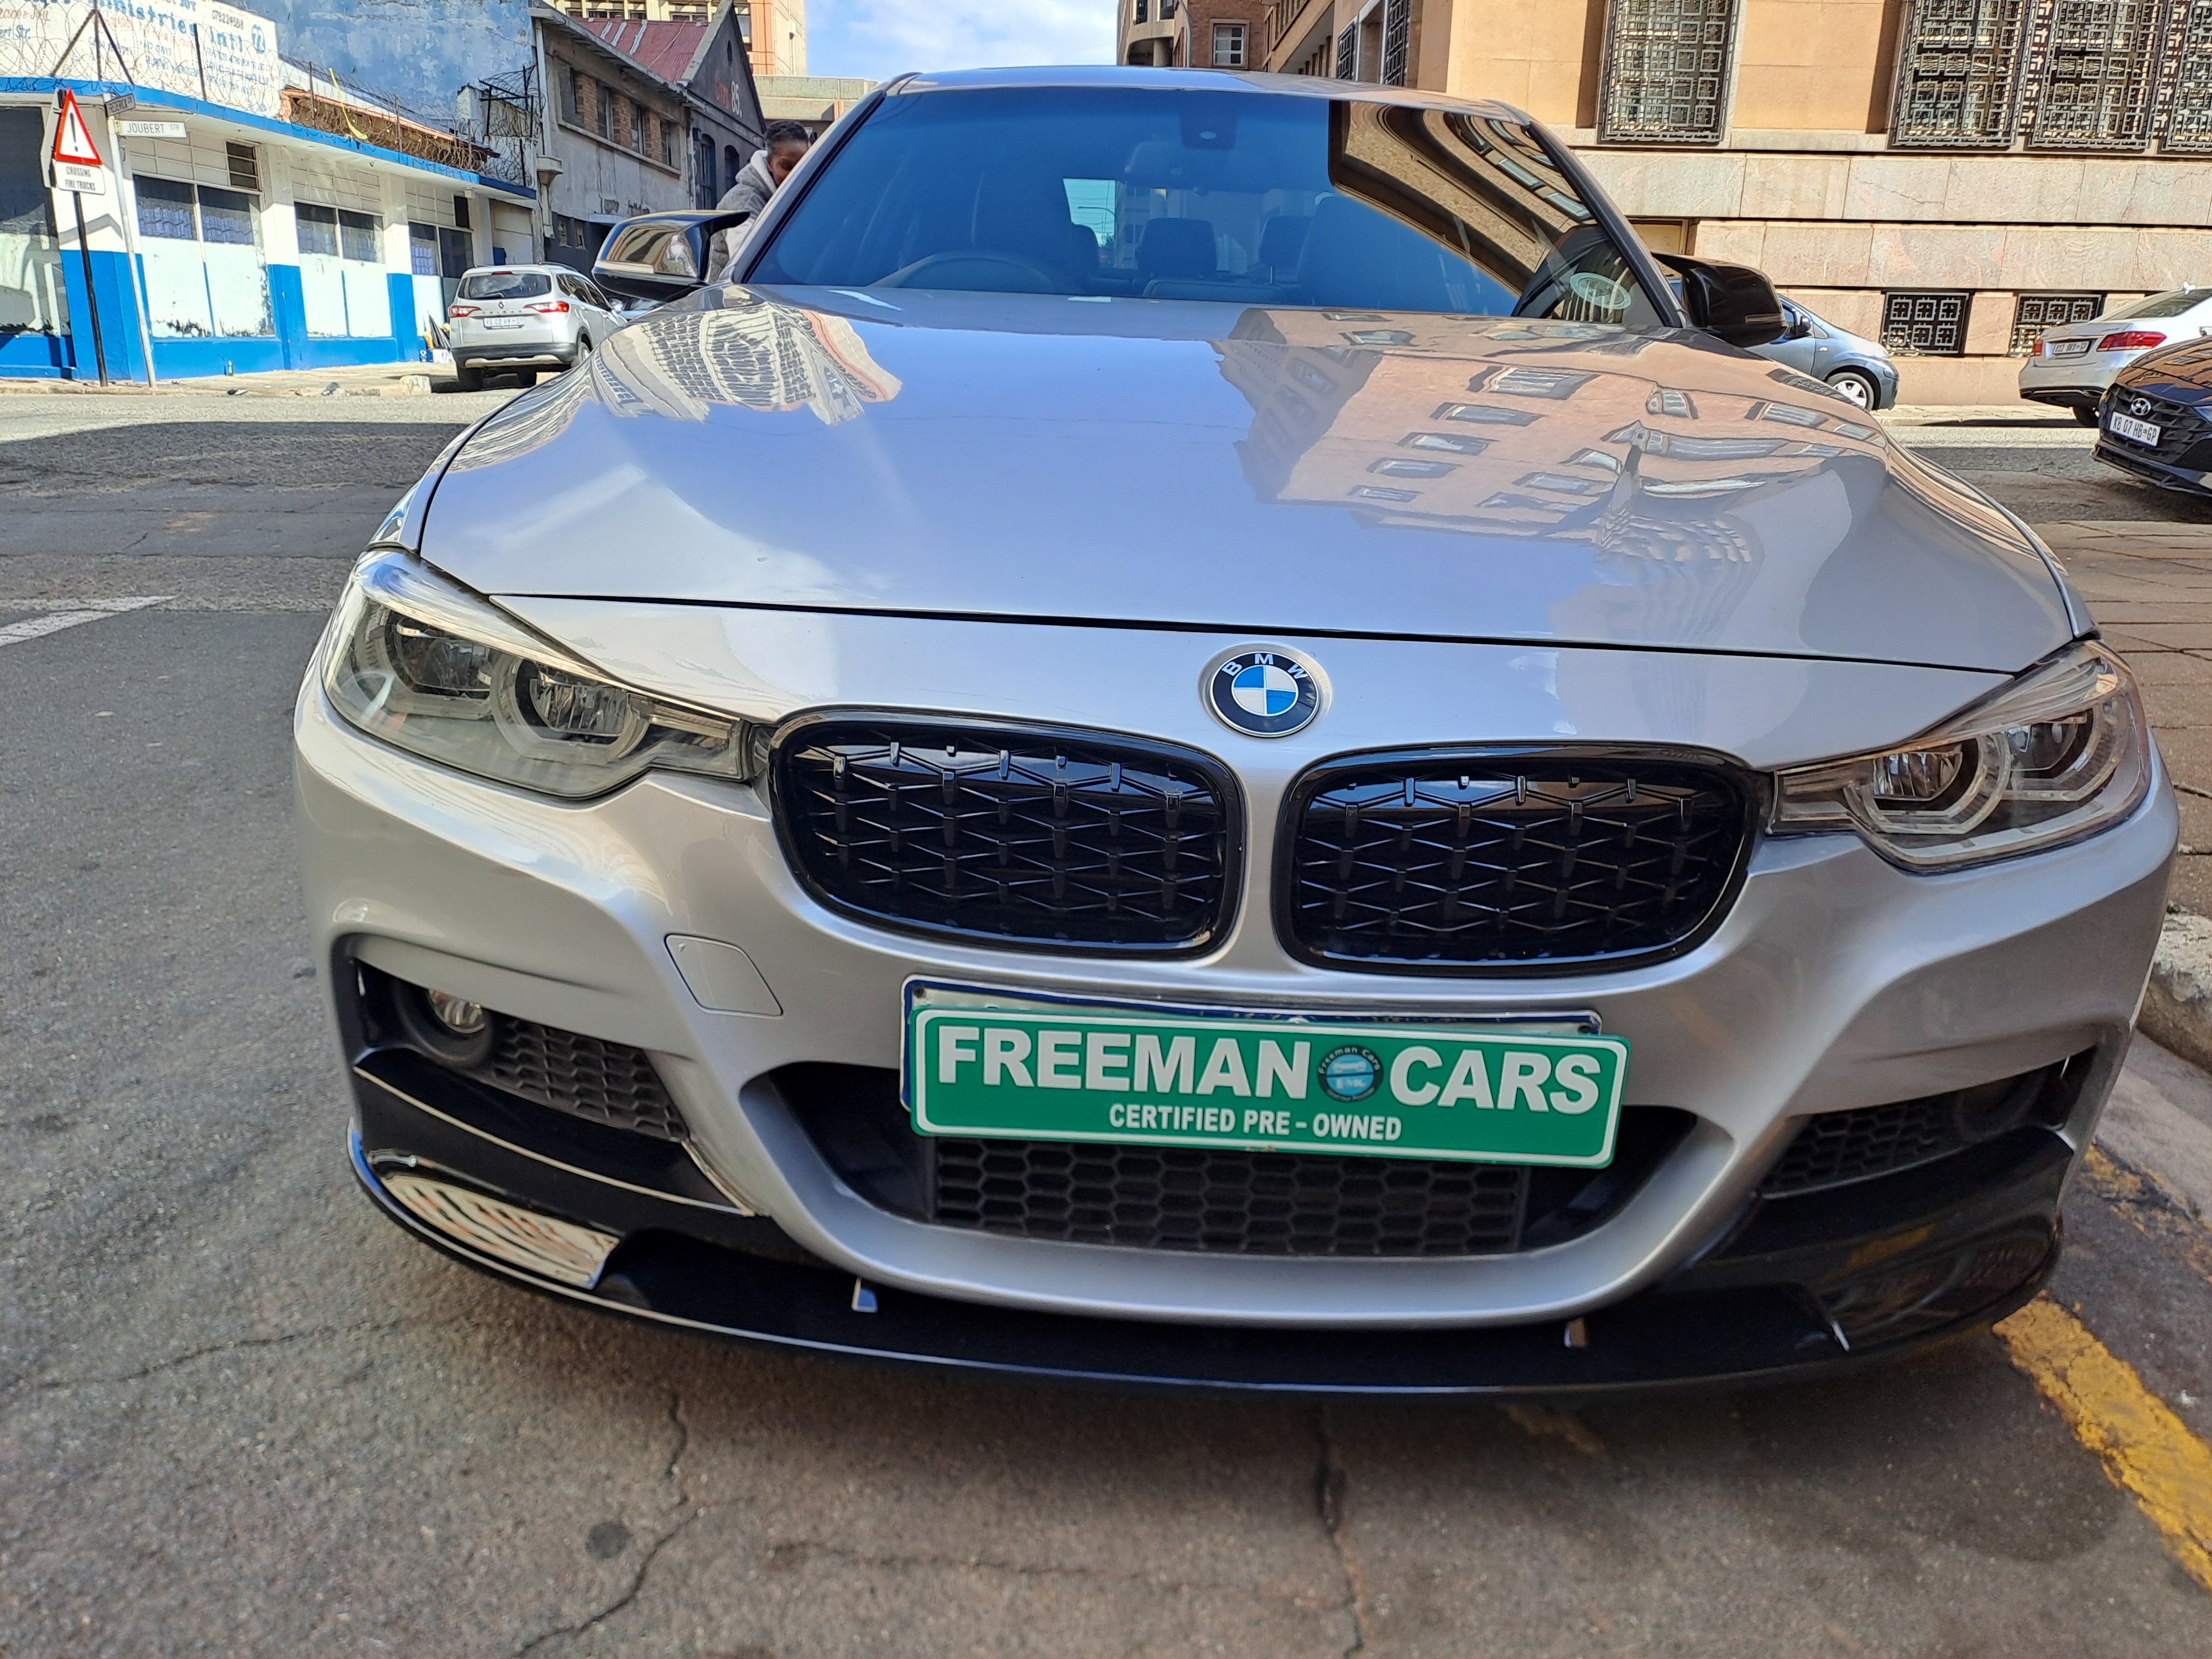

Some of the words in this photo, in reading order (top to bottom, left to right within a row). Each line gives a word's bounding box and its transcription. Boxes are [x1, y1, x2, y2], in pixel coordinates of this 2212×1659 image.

[127, 122, 165, 134] JOUBERT
[66, 166, 91, 178] CROSSING
[64, 179, 76, 189] FIRE
[76, 180, 96, 191] TRUCKS
[2122, 419, 2133, 435] 07
[2132, 422, 2143, 438] HB
[2146, 426, 2157, 442] GP
[1222, 653, 1309, 680] BMW
[938, 1025, 1312, 1100] FREEMAN
[1389, 1045, 1601, 1115] CARS
[1318, 1047, 1358, 1074] Freeman
[1361, 1048, 1381, 1071] Cars
[1109, 1103, 1236, 1133] CERTIFIED
